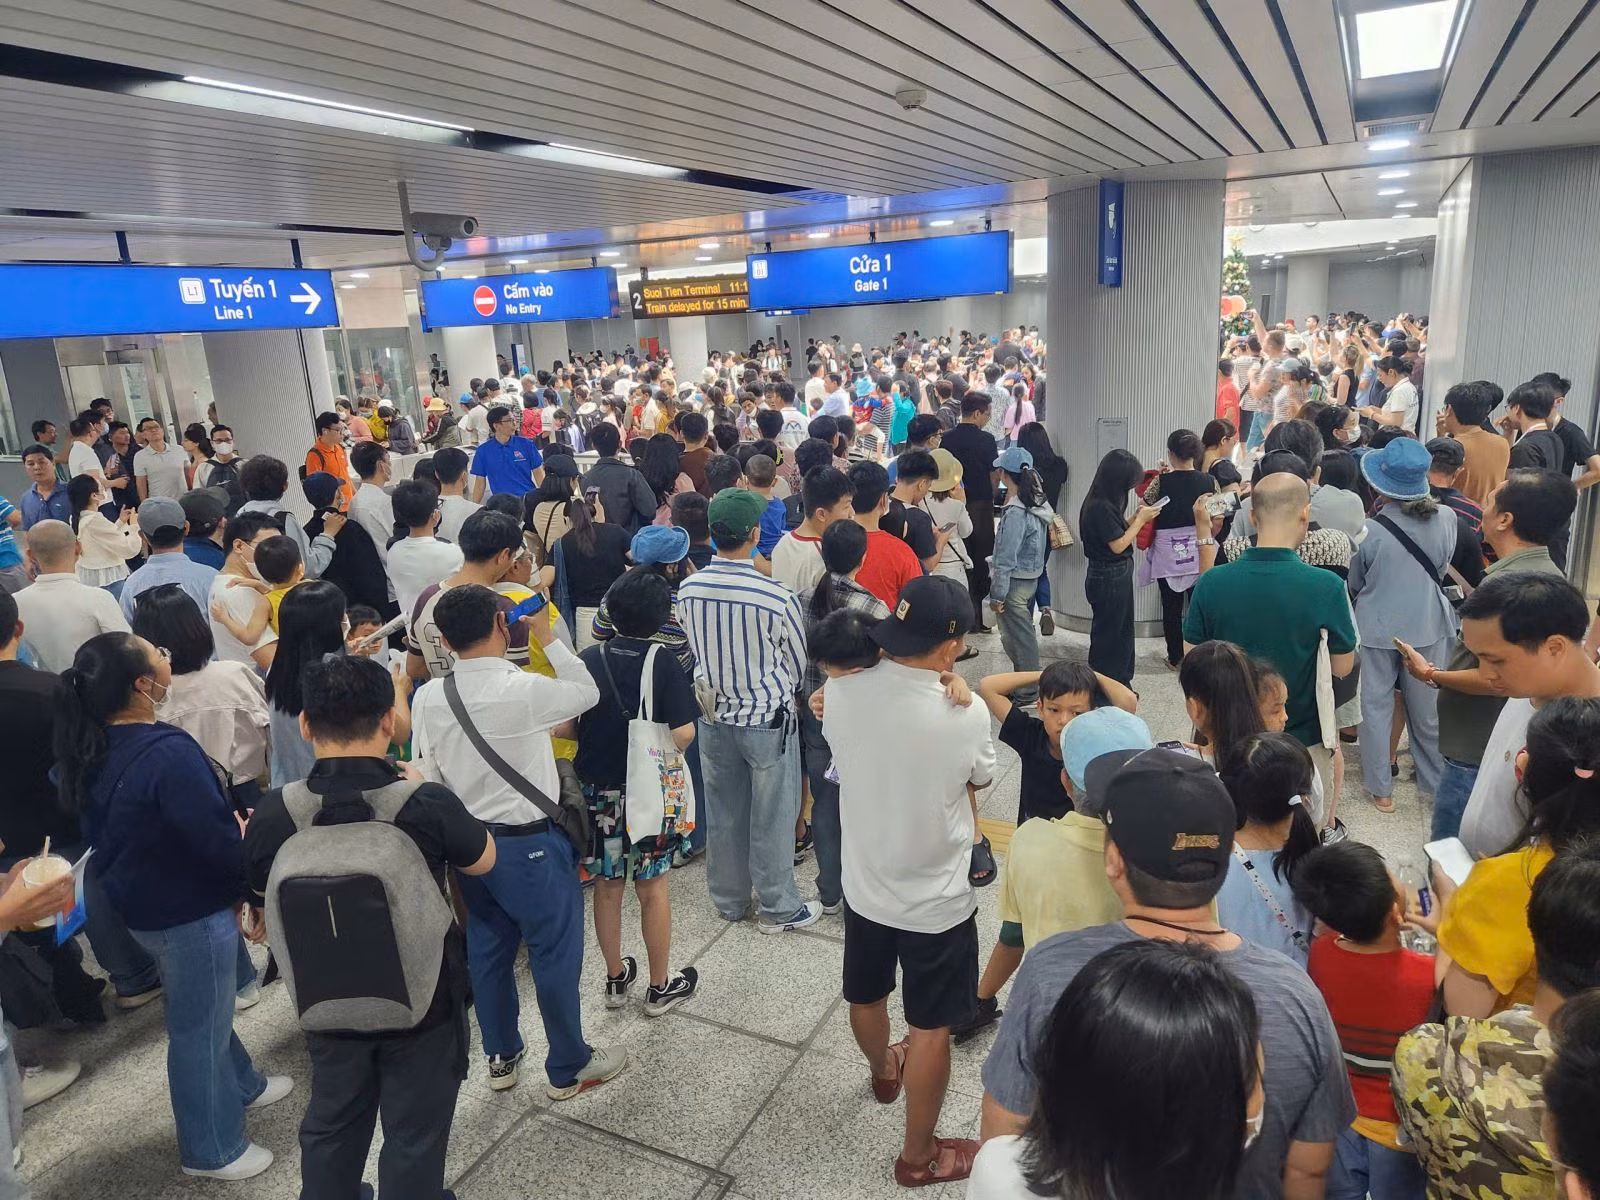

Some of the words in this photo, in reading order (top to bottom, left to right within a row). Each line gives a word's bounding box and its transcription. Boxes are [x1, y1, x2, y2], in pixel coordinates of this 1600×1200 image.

[850, 253, 880, 274] Cửa
[885, 253, 892, 272] 1
[187, 286, 198, 296] L1
[209, 276, 265, 303] Tuyến
[268, 279, 278, 298] 1
[503, 282, 530, 299] Cấm
[532, 281, 554, 297] vào
[664, 286, 683, 298] Tien
[684, 283, 720, 295] Terminal
[729, 281, 748, 293] 11:1
[854, 279, 880, 292] Gate
[882, 277, 888, 290] 1
[505, 303, 518, 315] No
[519, 302, 542, 316] Entry
[632, 292, 642, 310] 2
[645, 302, 667, 314] Train
[668, 299, 701, 313] delayed
[702, 299, 714, 310] for
[717, 298, 728, 309] 15
[214, 304, 244, 320] Line
[246, 305, 254, 319] 1
